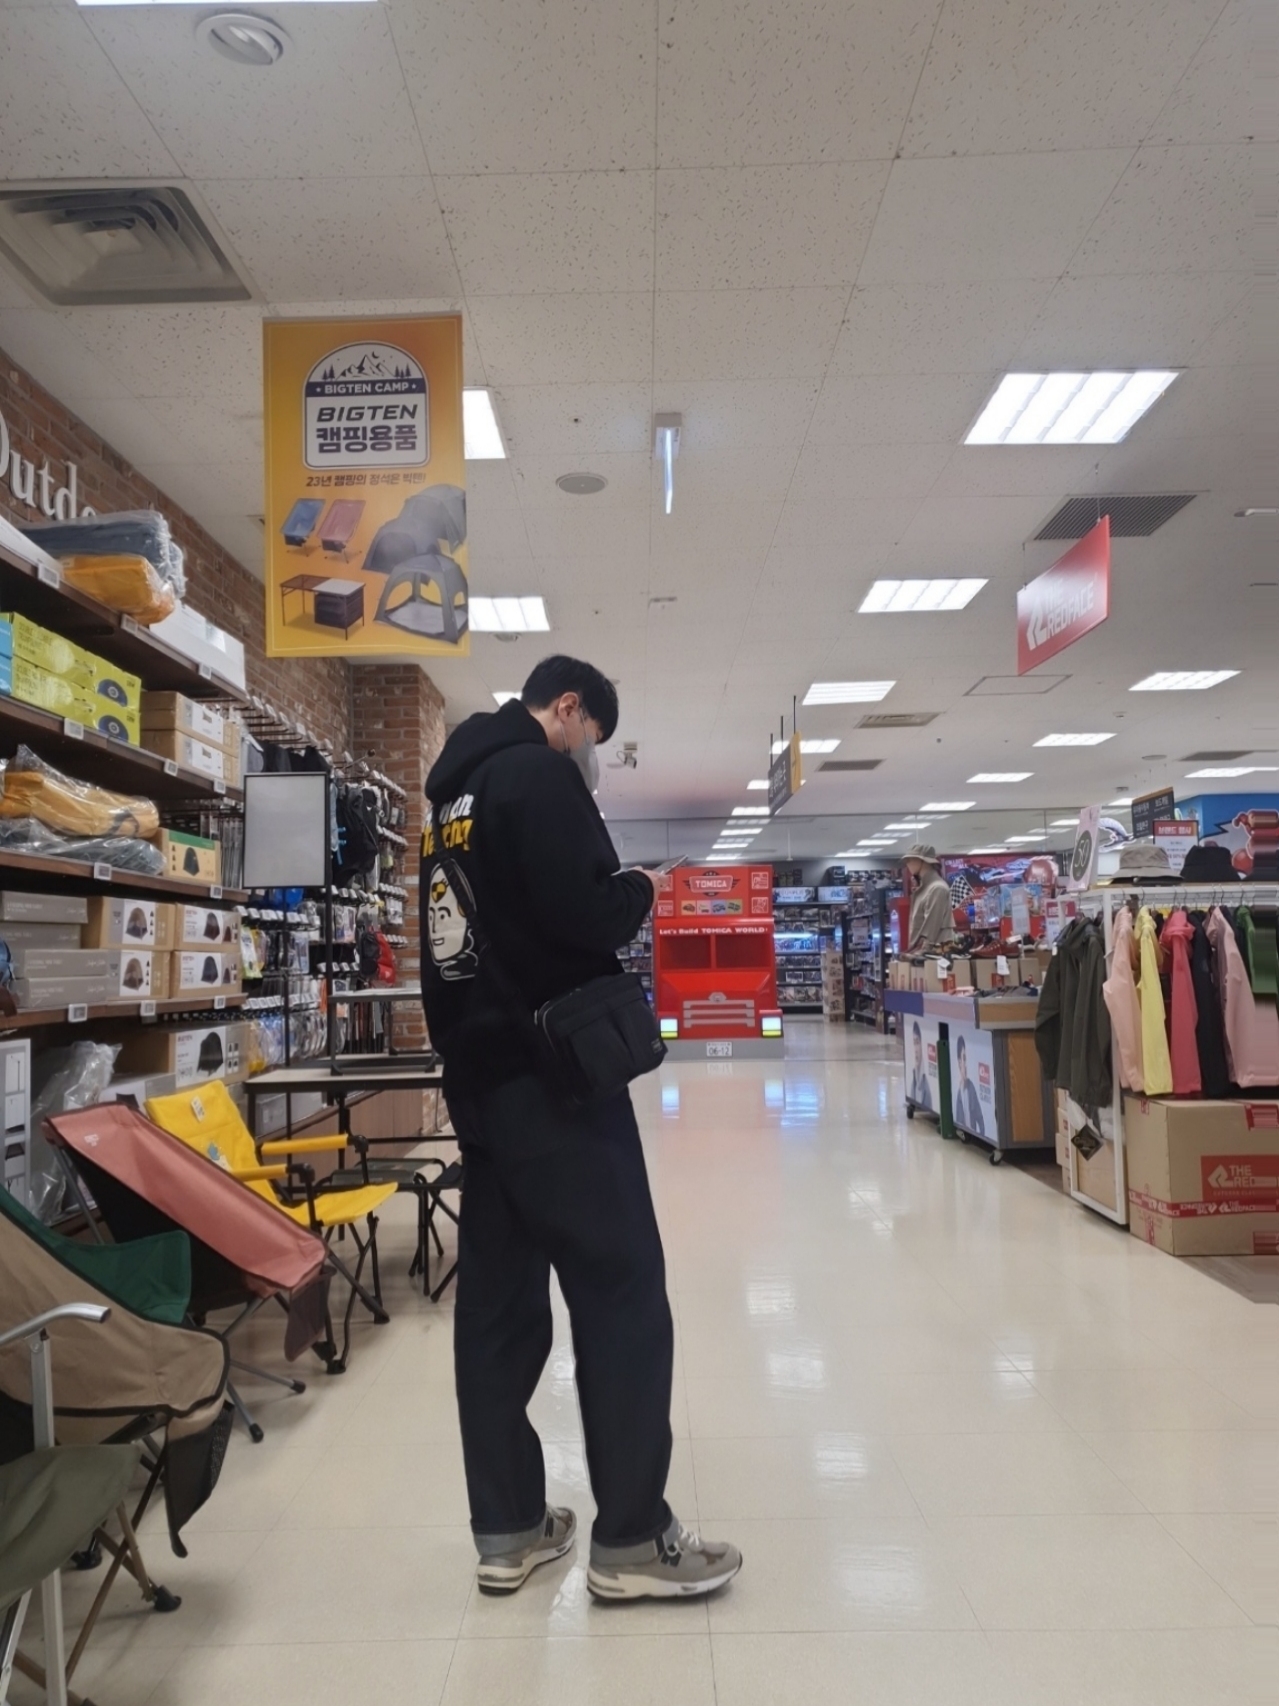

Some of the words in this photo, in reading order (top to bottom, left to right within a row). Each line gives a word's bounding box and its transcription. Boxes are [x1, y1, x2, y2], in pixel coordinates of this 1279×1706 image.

[324, 383, 372, 394] BIGTEN
[374, 381, 409, 392] CAMP
[316, 404, 418, 422] BIGTEN
[316, 424, 418, 454] 캠핑용품
[306, 476, 332, 487] 23년
[334, 474, 367, 486] 캠핑의
[369, 473, 401, 486] 정석은
[1047, 581, 1095, 640] REDFACE
[695, 880, 727, 888] TOMICA
[1228, 1164, 1252, 1177] THE
